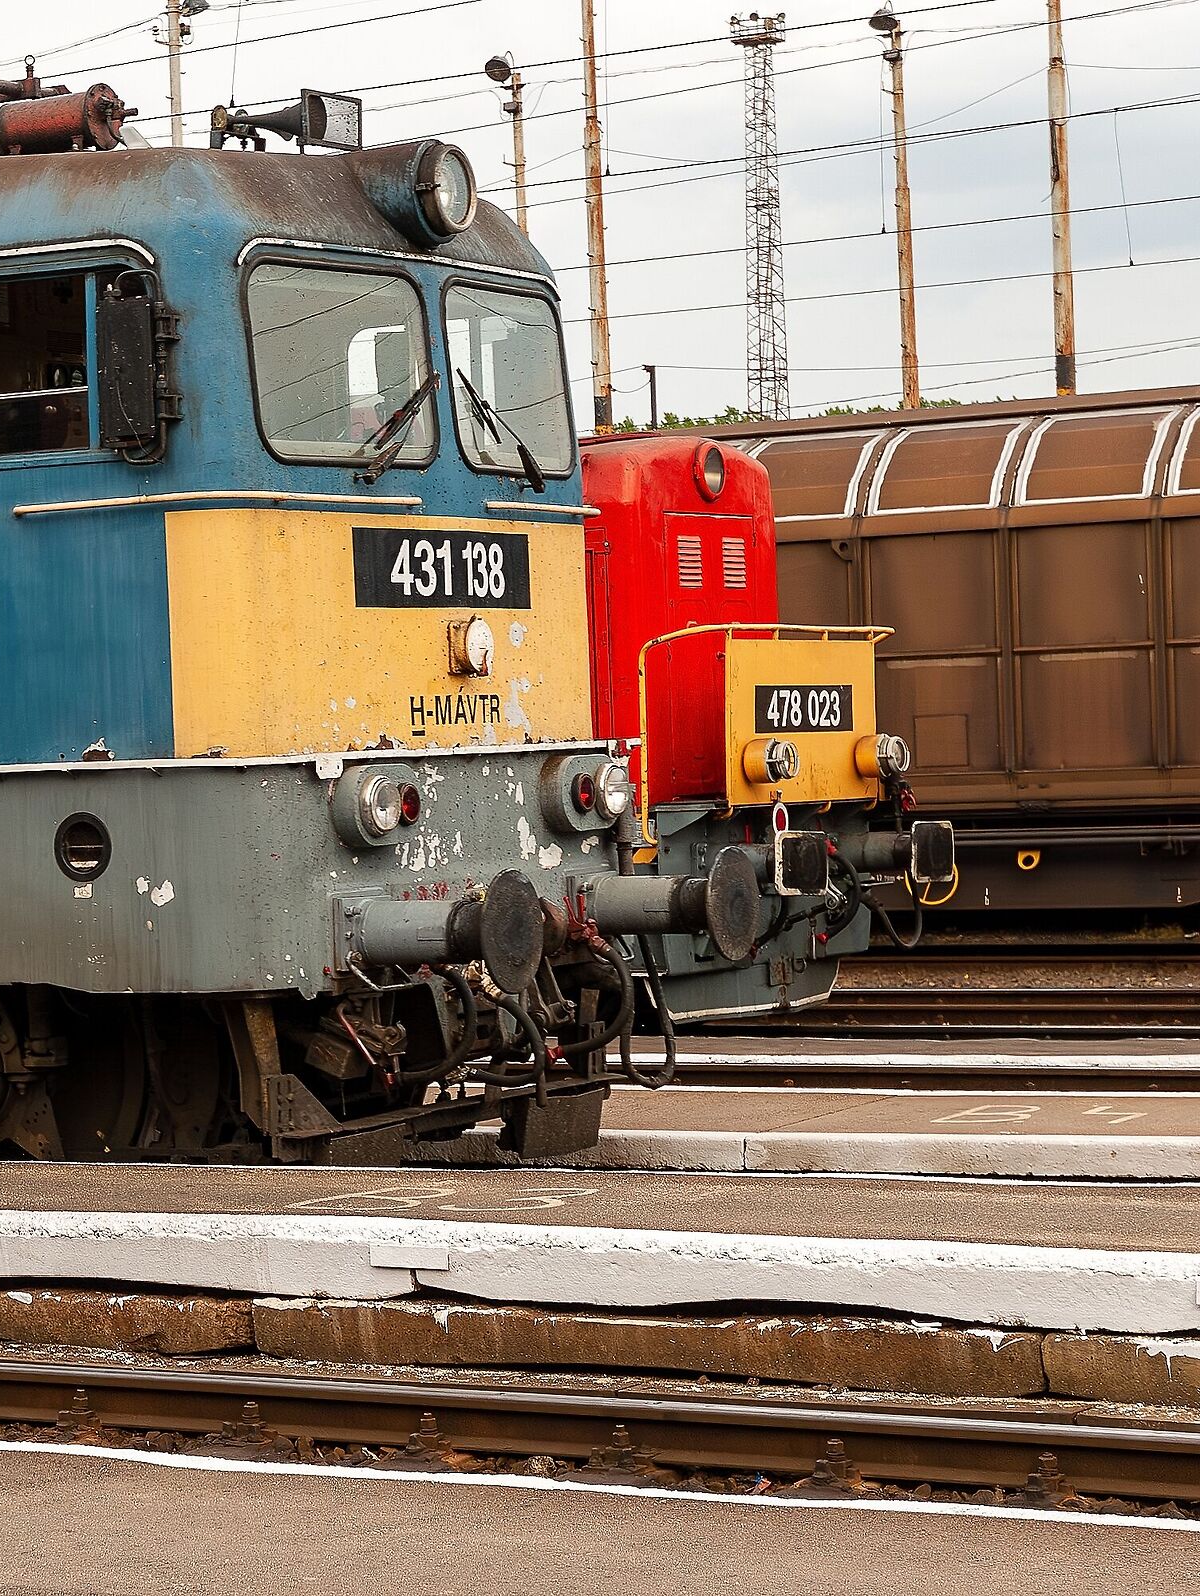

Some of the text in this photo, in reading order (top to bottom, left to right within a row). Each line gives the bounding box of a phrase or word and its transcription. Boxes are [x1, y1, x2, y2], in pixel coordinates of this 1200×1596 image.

[391, 539, 506, 599] 431 138
[410, 686, 501, 727] H-MÁVTR
[767, 689, 841, 728] 478 023
